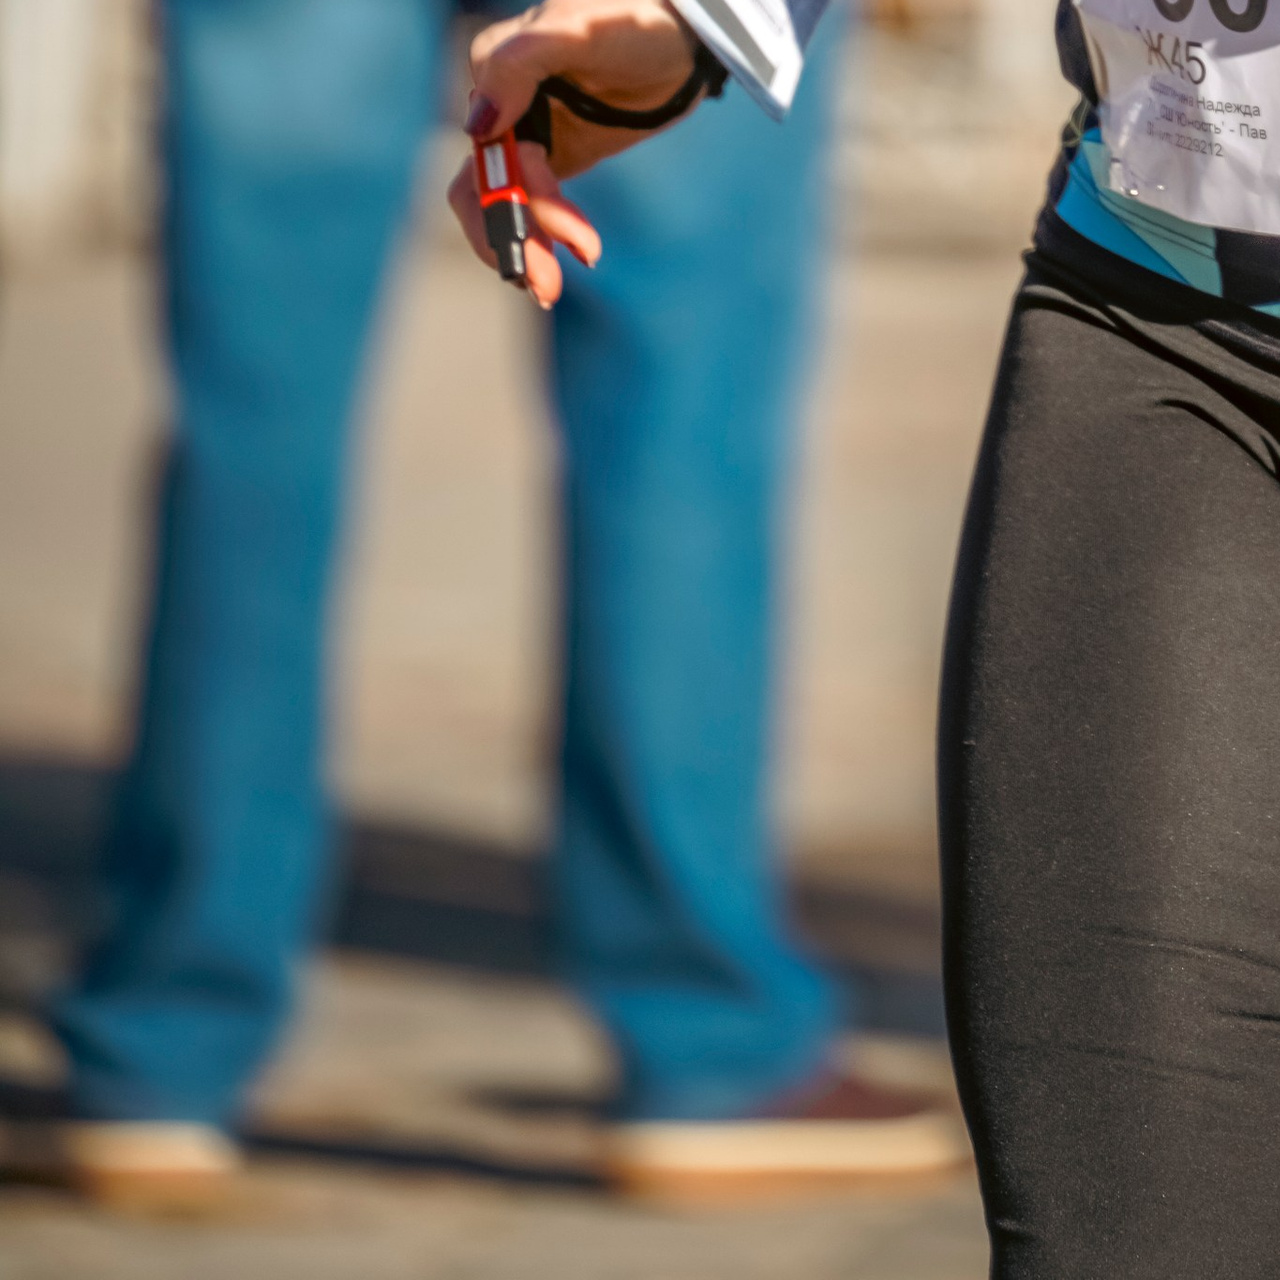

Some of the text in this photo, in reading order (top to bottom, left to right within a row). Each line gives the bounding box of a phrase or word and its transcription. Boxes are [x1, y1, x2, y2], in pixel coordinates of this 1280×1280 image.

[1134, 25, 1207, 86] Ж45
[1196, 96, 1262, 118] Надежда
[1239, 122, 1268, 140] Пав
